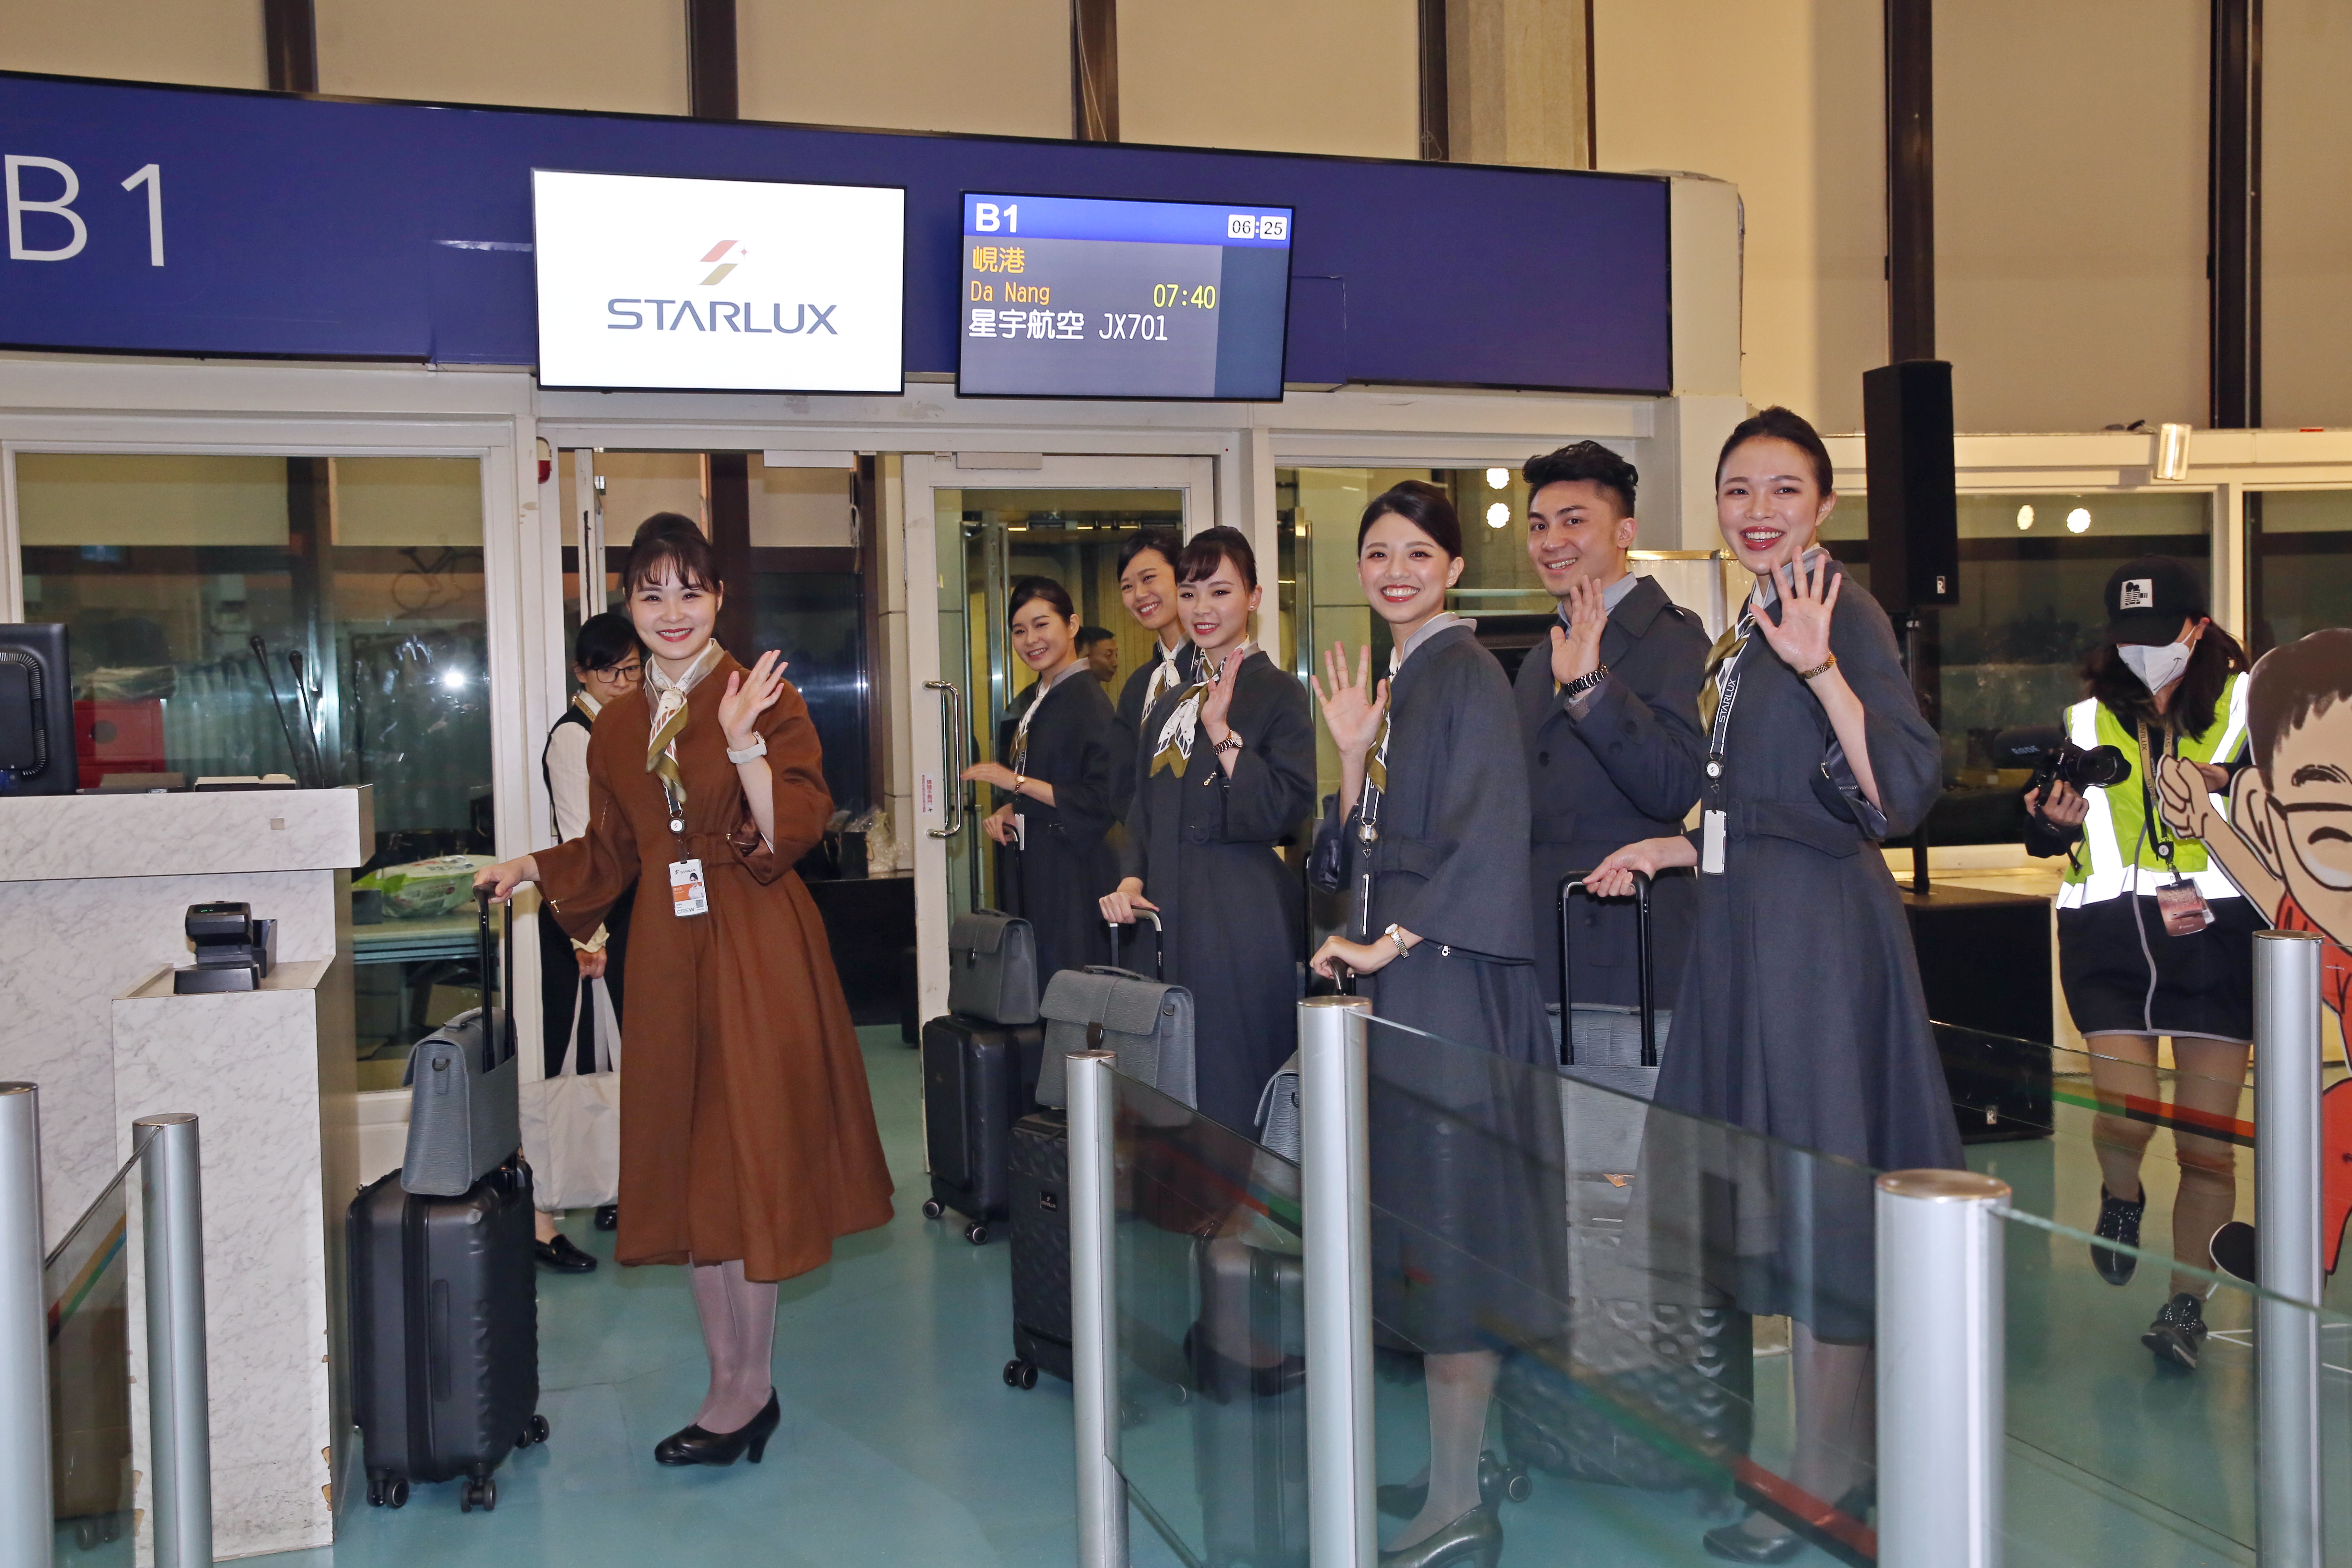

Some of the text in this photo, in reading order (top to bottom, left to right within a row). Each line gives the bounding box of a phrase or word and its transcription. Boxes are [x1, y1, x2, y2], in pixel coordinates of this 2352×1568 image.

[975, 203, 1018, 234] B1
[1232, 219, 1283, 236] 06:25
[972, 245, 1025, 274] 峴港
[970, 280, 1050, 306] Da Nang
[1154, 283, 1216, 309] 07:40
[607, 298, 838, 335] STARLUX
[968, 308, 1168, 341] 星宇航空 JX701
[1718, 678, 1736, 723] STARLUX
[2139, 722, 2147, 751] TARLUX
